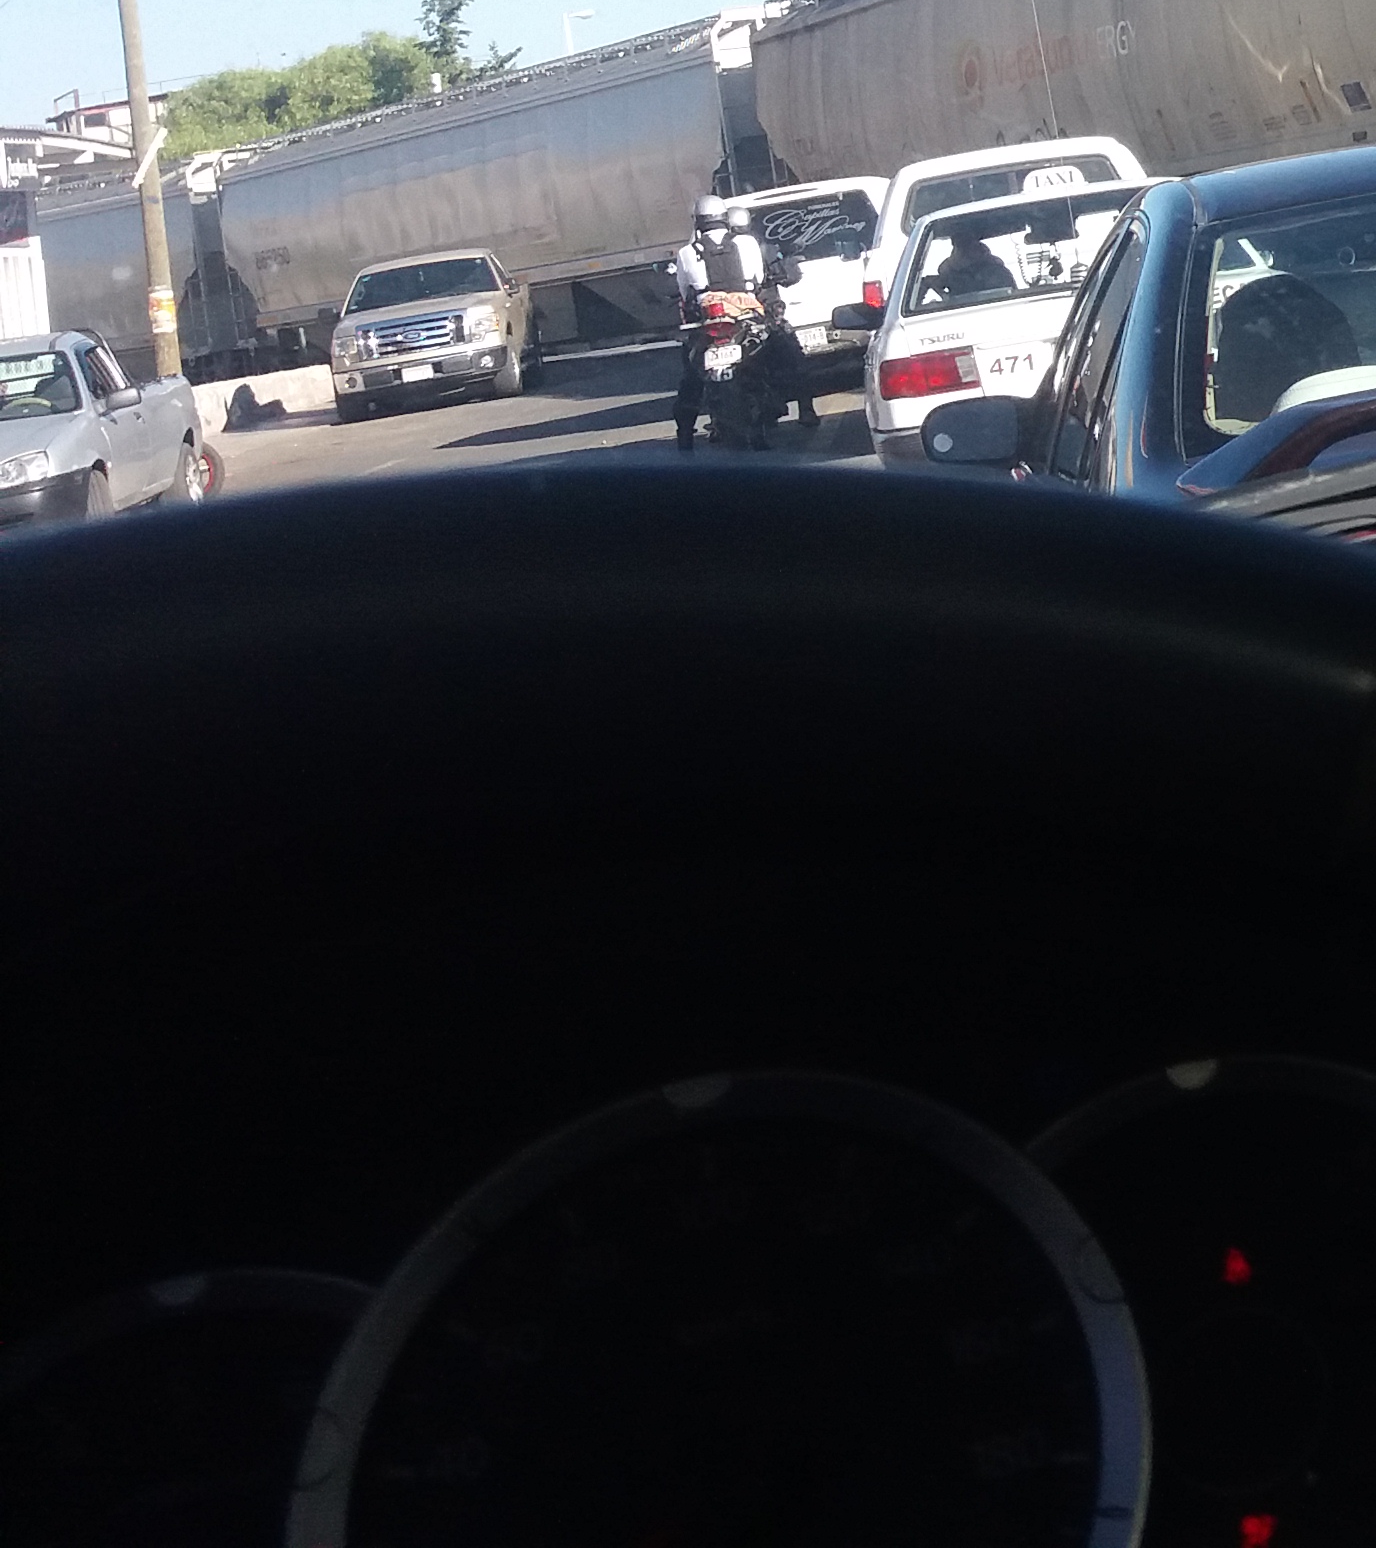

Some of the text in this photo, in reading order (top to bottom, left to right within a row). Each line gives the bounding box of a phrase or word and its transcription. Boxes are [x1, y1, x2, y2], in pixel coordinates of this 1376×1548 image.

[1034, 170, 1075, 188] TAXI
[918, 332, 965, 346] TSURU
[989, 353, 1035, 376] 471
